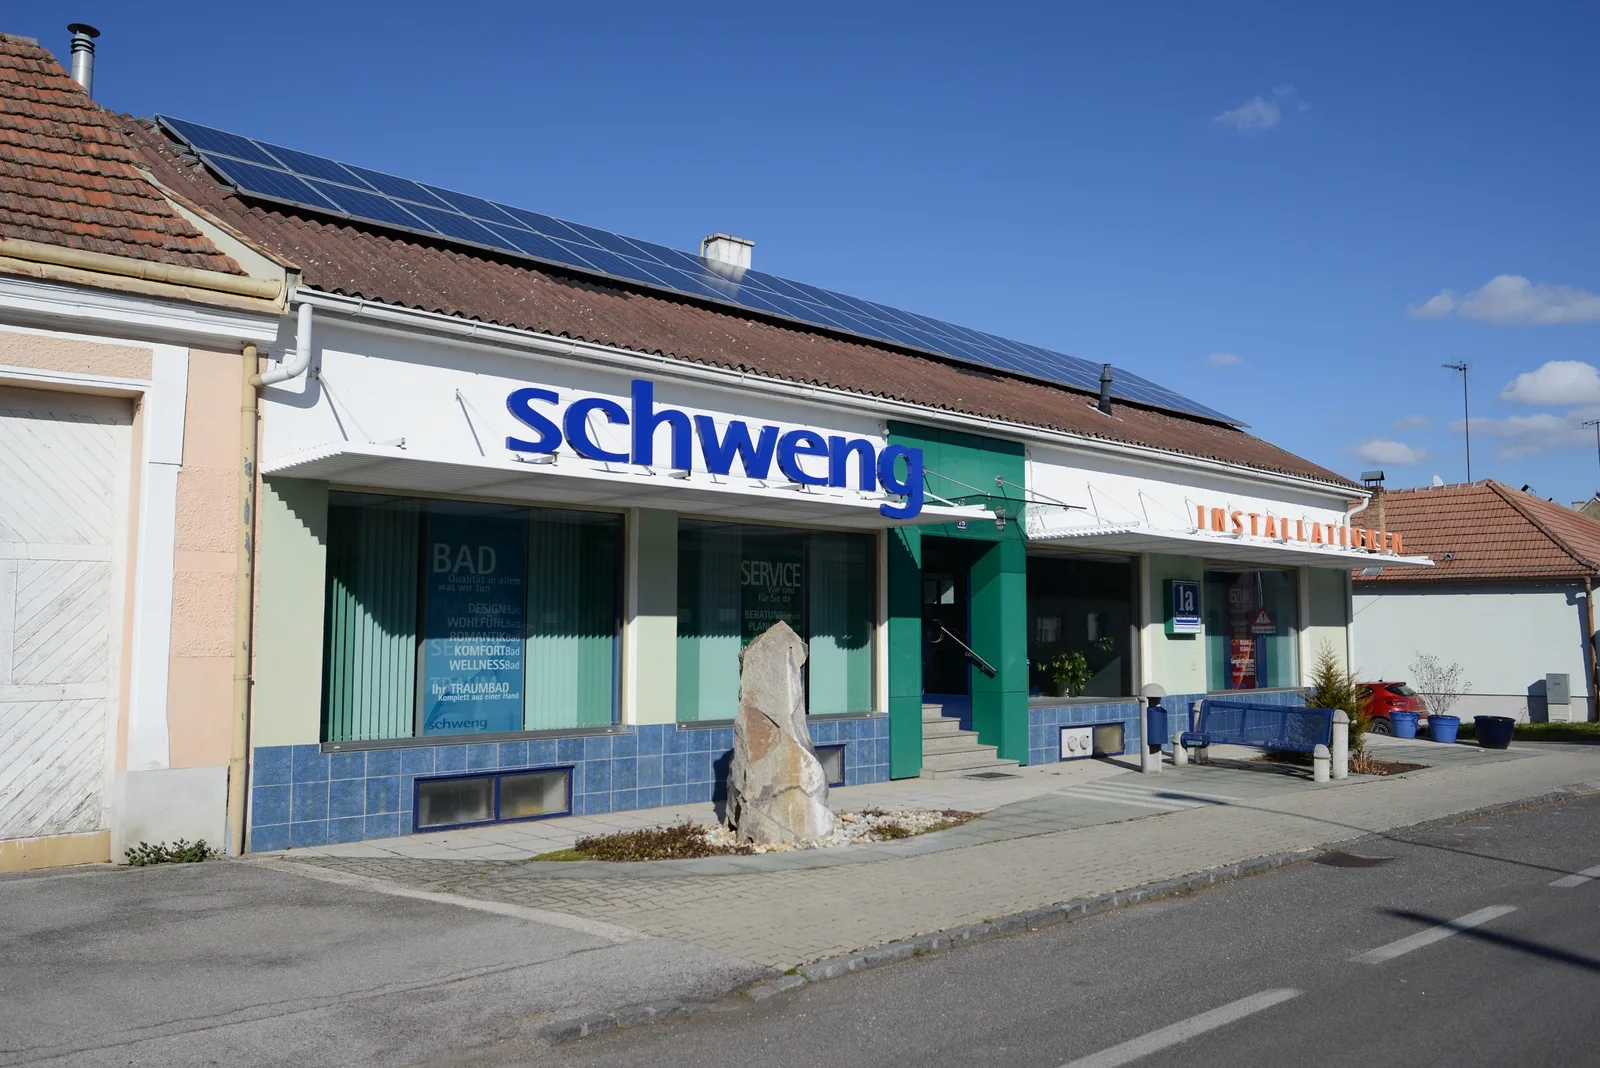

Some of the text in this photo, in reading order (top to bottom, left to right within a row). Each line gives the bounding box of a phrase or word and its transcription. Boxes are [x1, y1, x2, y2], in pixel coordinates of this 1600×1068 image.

[506, 380, 924, 519] schweng
[1197, 505, 1403, 553] INSTALLATIONEN
[433, 543, 496, 574] BAD
[448, 573, 521, 585] Qualität in allem
[740, 560, 801, 588] SERVICE
[438, 583, 491, 593] was wir tun
[770, 593, 781, 602] Sie
[782, 594, 791, 603] da
[1179, 585, 1194, 612] 1a
[431, 682, 510, 695] Ihr TRAUMBAD
[438, 694, 470, 703] Komplett
[502, 692, 519, 700] Hand
[428, 718, 488, 730] schweng
